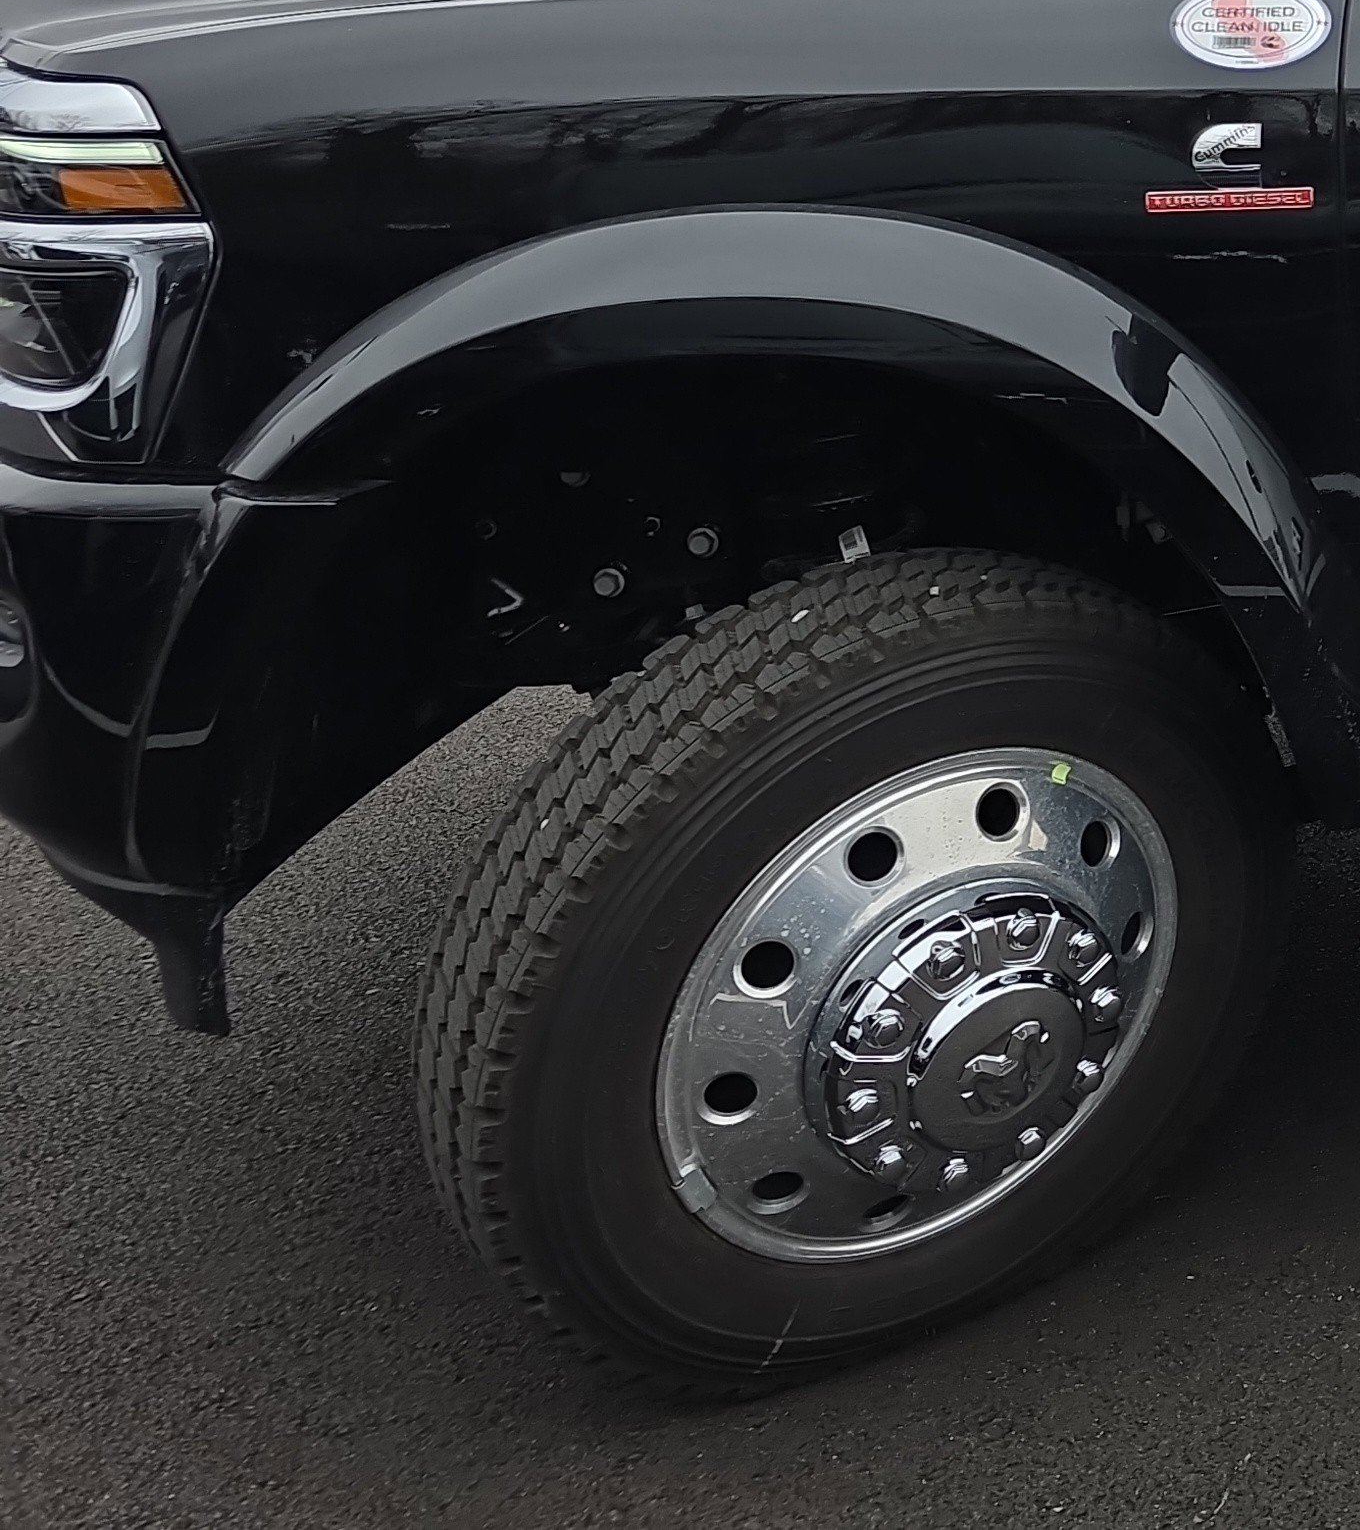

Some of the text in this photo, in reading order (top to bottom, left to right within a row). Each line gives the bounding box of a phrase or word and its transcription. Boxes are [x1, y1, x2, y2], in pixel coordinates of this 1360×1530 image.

[1201, 6, 1296, 18] CERTIFIED
[1191, 20, 1304, 33] CLEAN IDLE
[1194, 125, 1256, 163] Cummins
[1150, 191, 1310, 208] TURBO DIESEL
